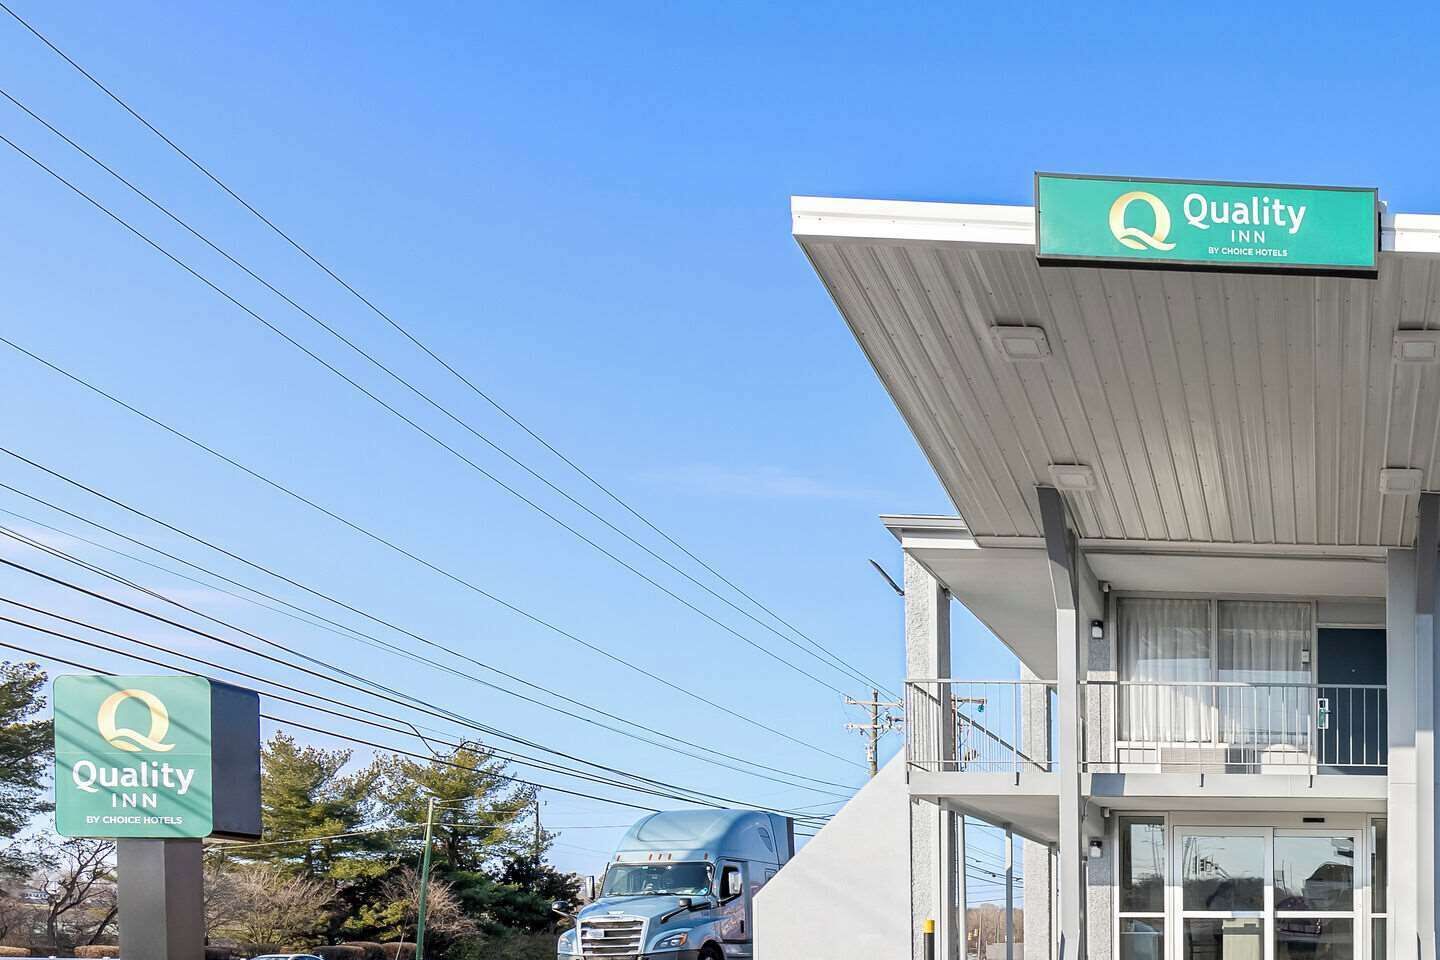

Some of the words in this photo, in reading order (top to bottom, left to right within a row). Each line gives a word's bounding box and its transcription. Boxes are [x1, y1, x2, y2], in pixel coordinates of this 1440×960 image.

[1183, 193, 1306, 234] Quality
[1231, 229, 1265, 243] INN
[1208, 246, 1219, 255] BY
[1221, 247, 1254, 256] CHOICE
[1255, 248, 1288, 257] HOTELS
[72, 760, 195, 795] Quality
[112, 793, 157, 808] INN
[86, 815, 100, 824] BY
[102, 815, 141, 824] CHOICE
[143, 815, 183, 825] HOTELS
